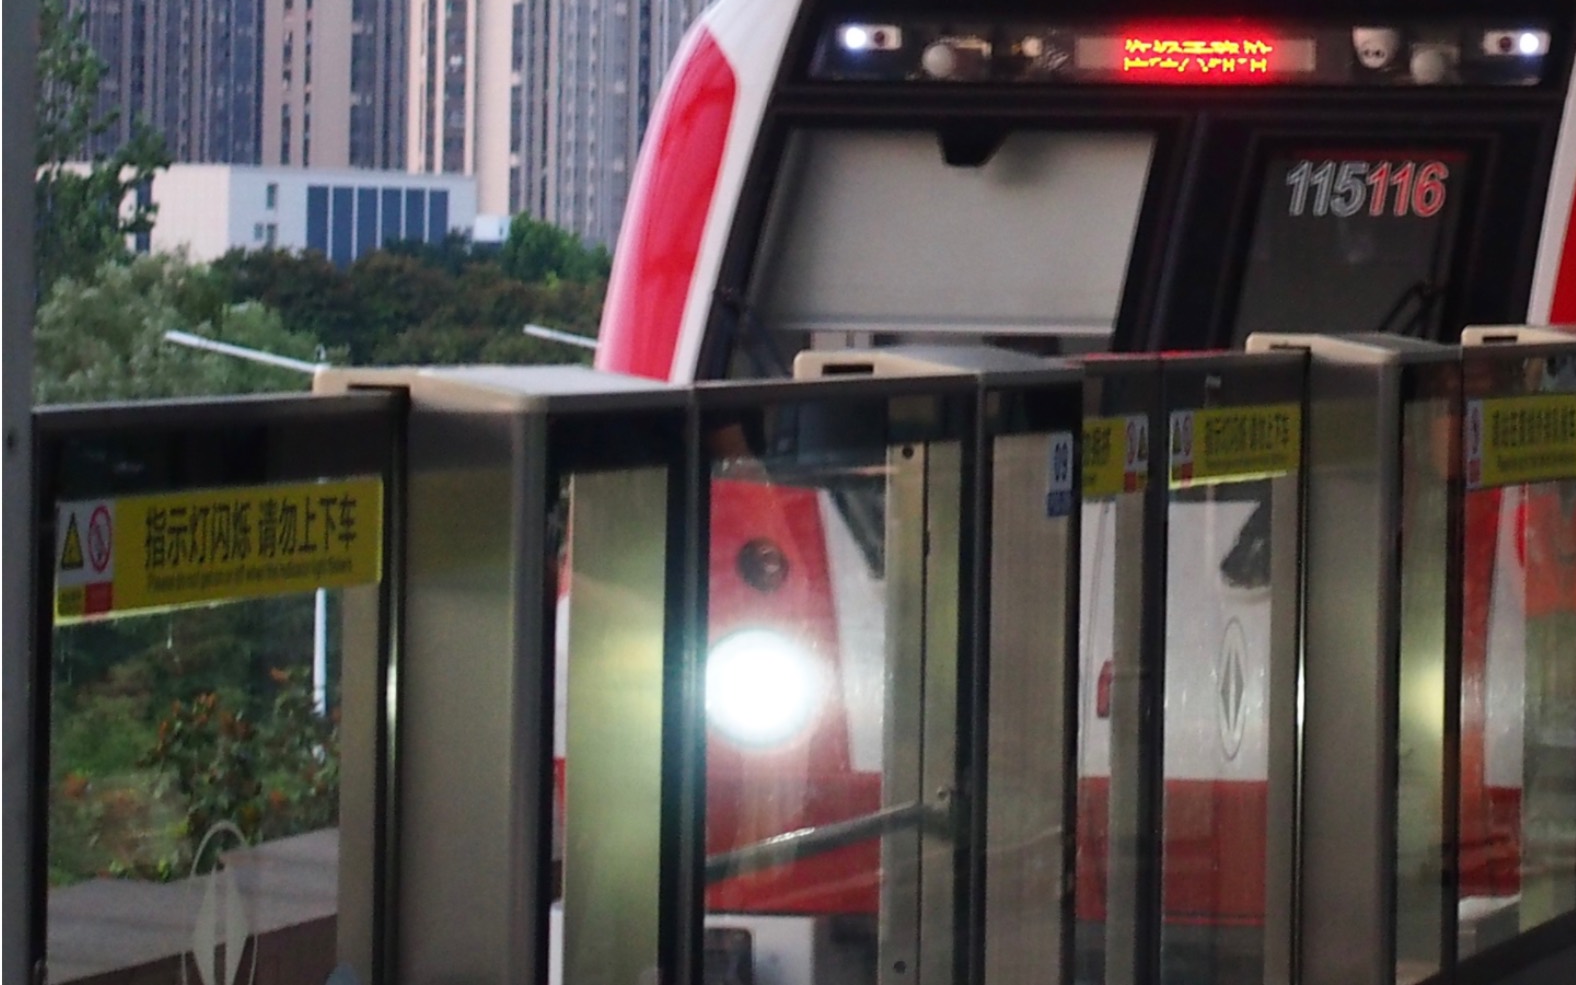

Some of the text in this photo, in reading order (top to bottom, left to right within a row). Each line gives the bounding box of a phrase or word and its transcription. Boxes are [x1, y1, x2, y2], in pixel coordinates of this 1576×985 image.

[1286, 160, 1449, 217] 115116
[144, 492, 358, 568] 指示灯闪烁 请勿上下车
